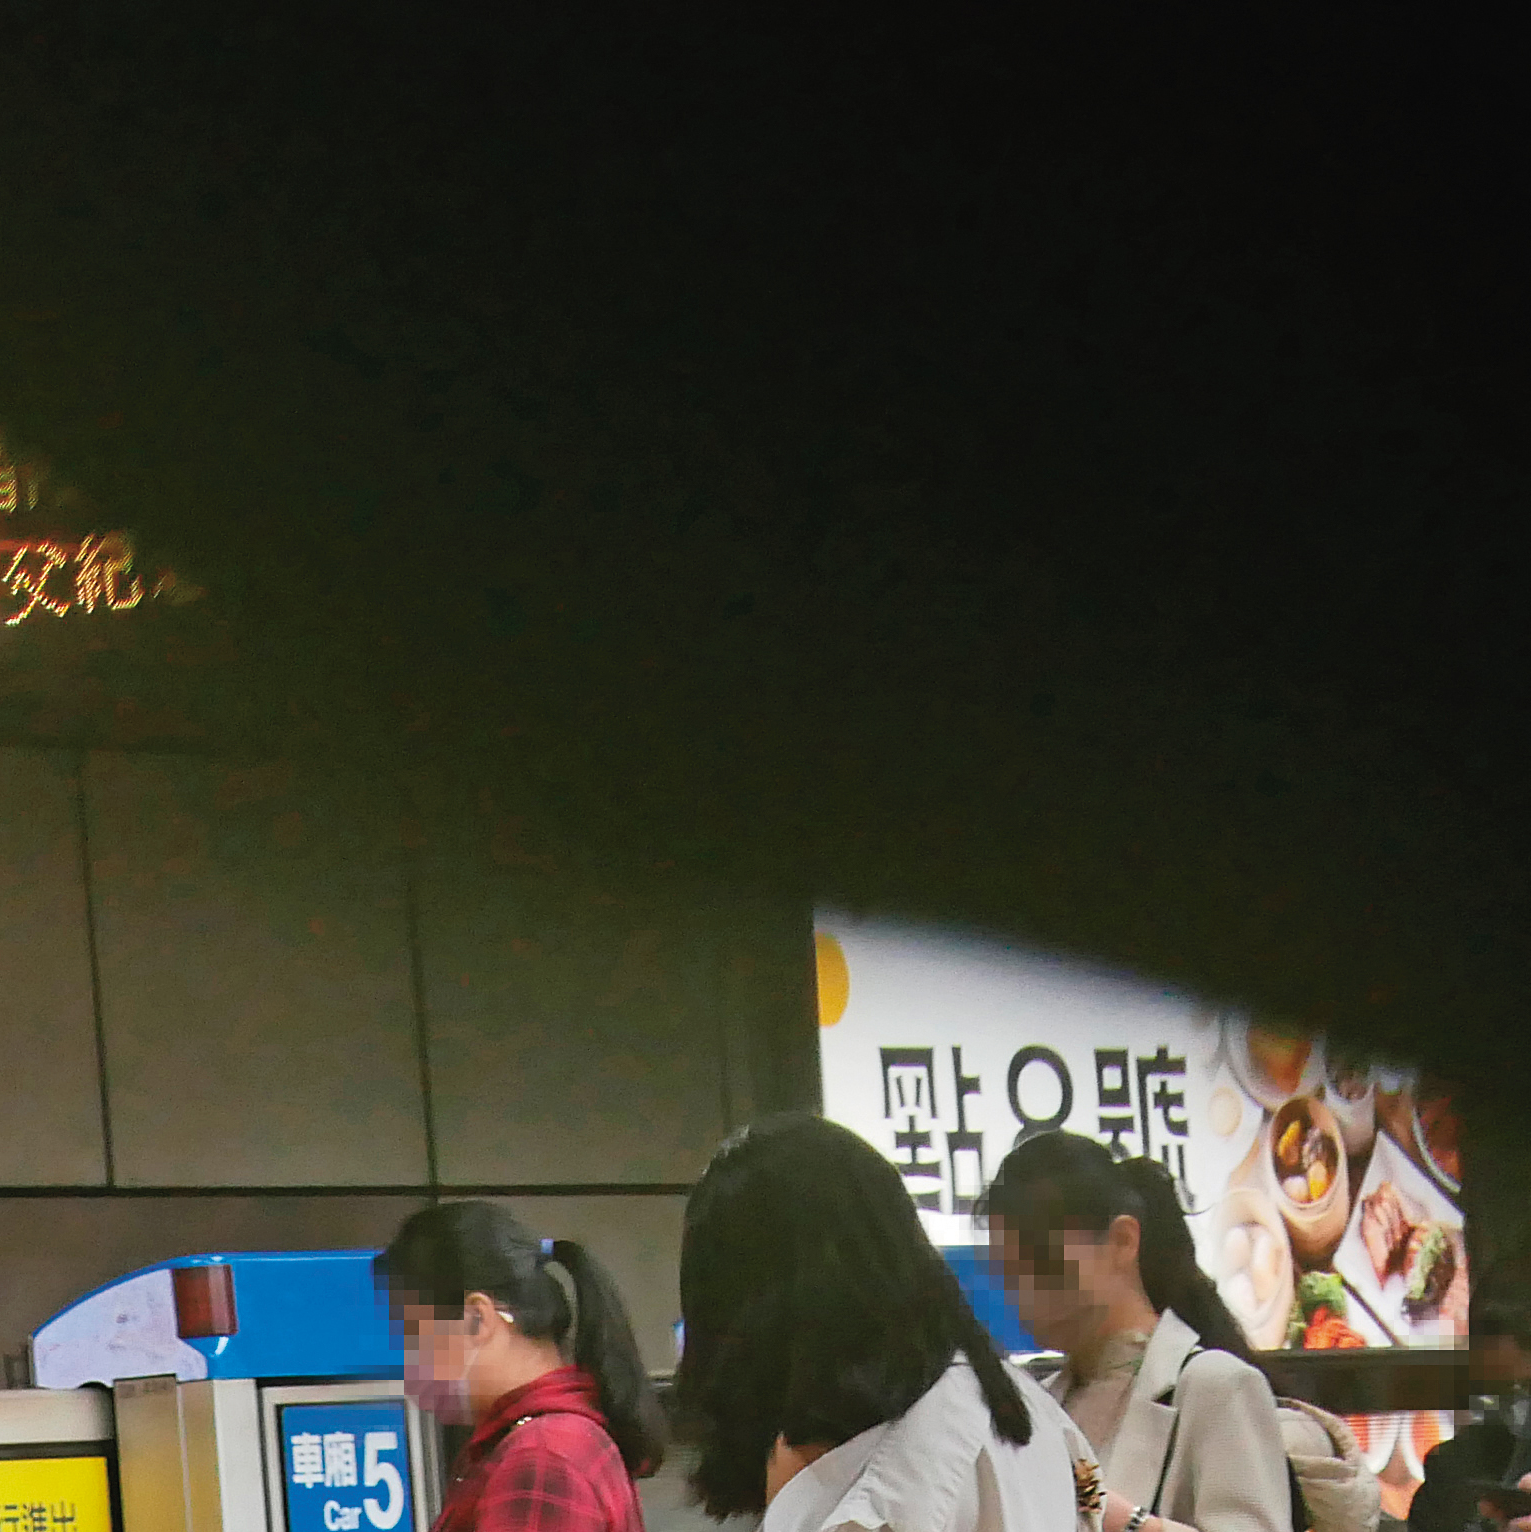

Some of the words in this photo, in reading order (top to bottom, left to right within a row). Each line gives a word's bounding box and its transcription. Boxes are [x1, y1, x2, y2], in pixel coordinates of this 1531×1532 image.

[290, 1431, 358, 1490] 車廂
[363, 1431, 404, 1531] 5
[324, 1500, 363, 1532] Car
